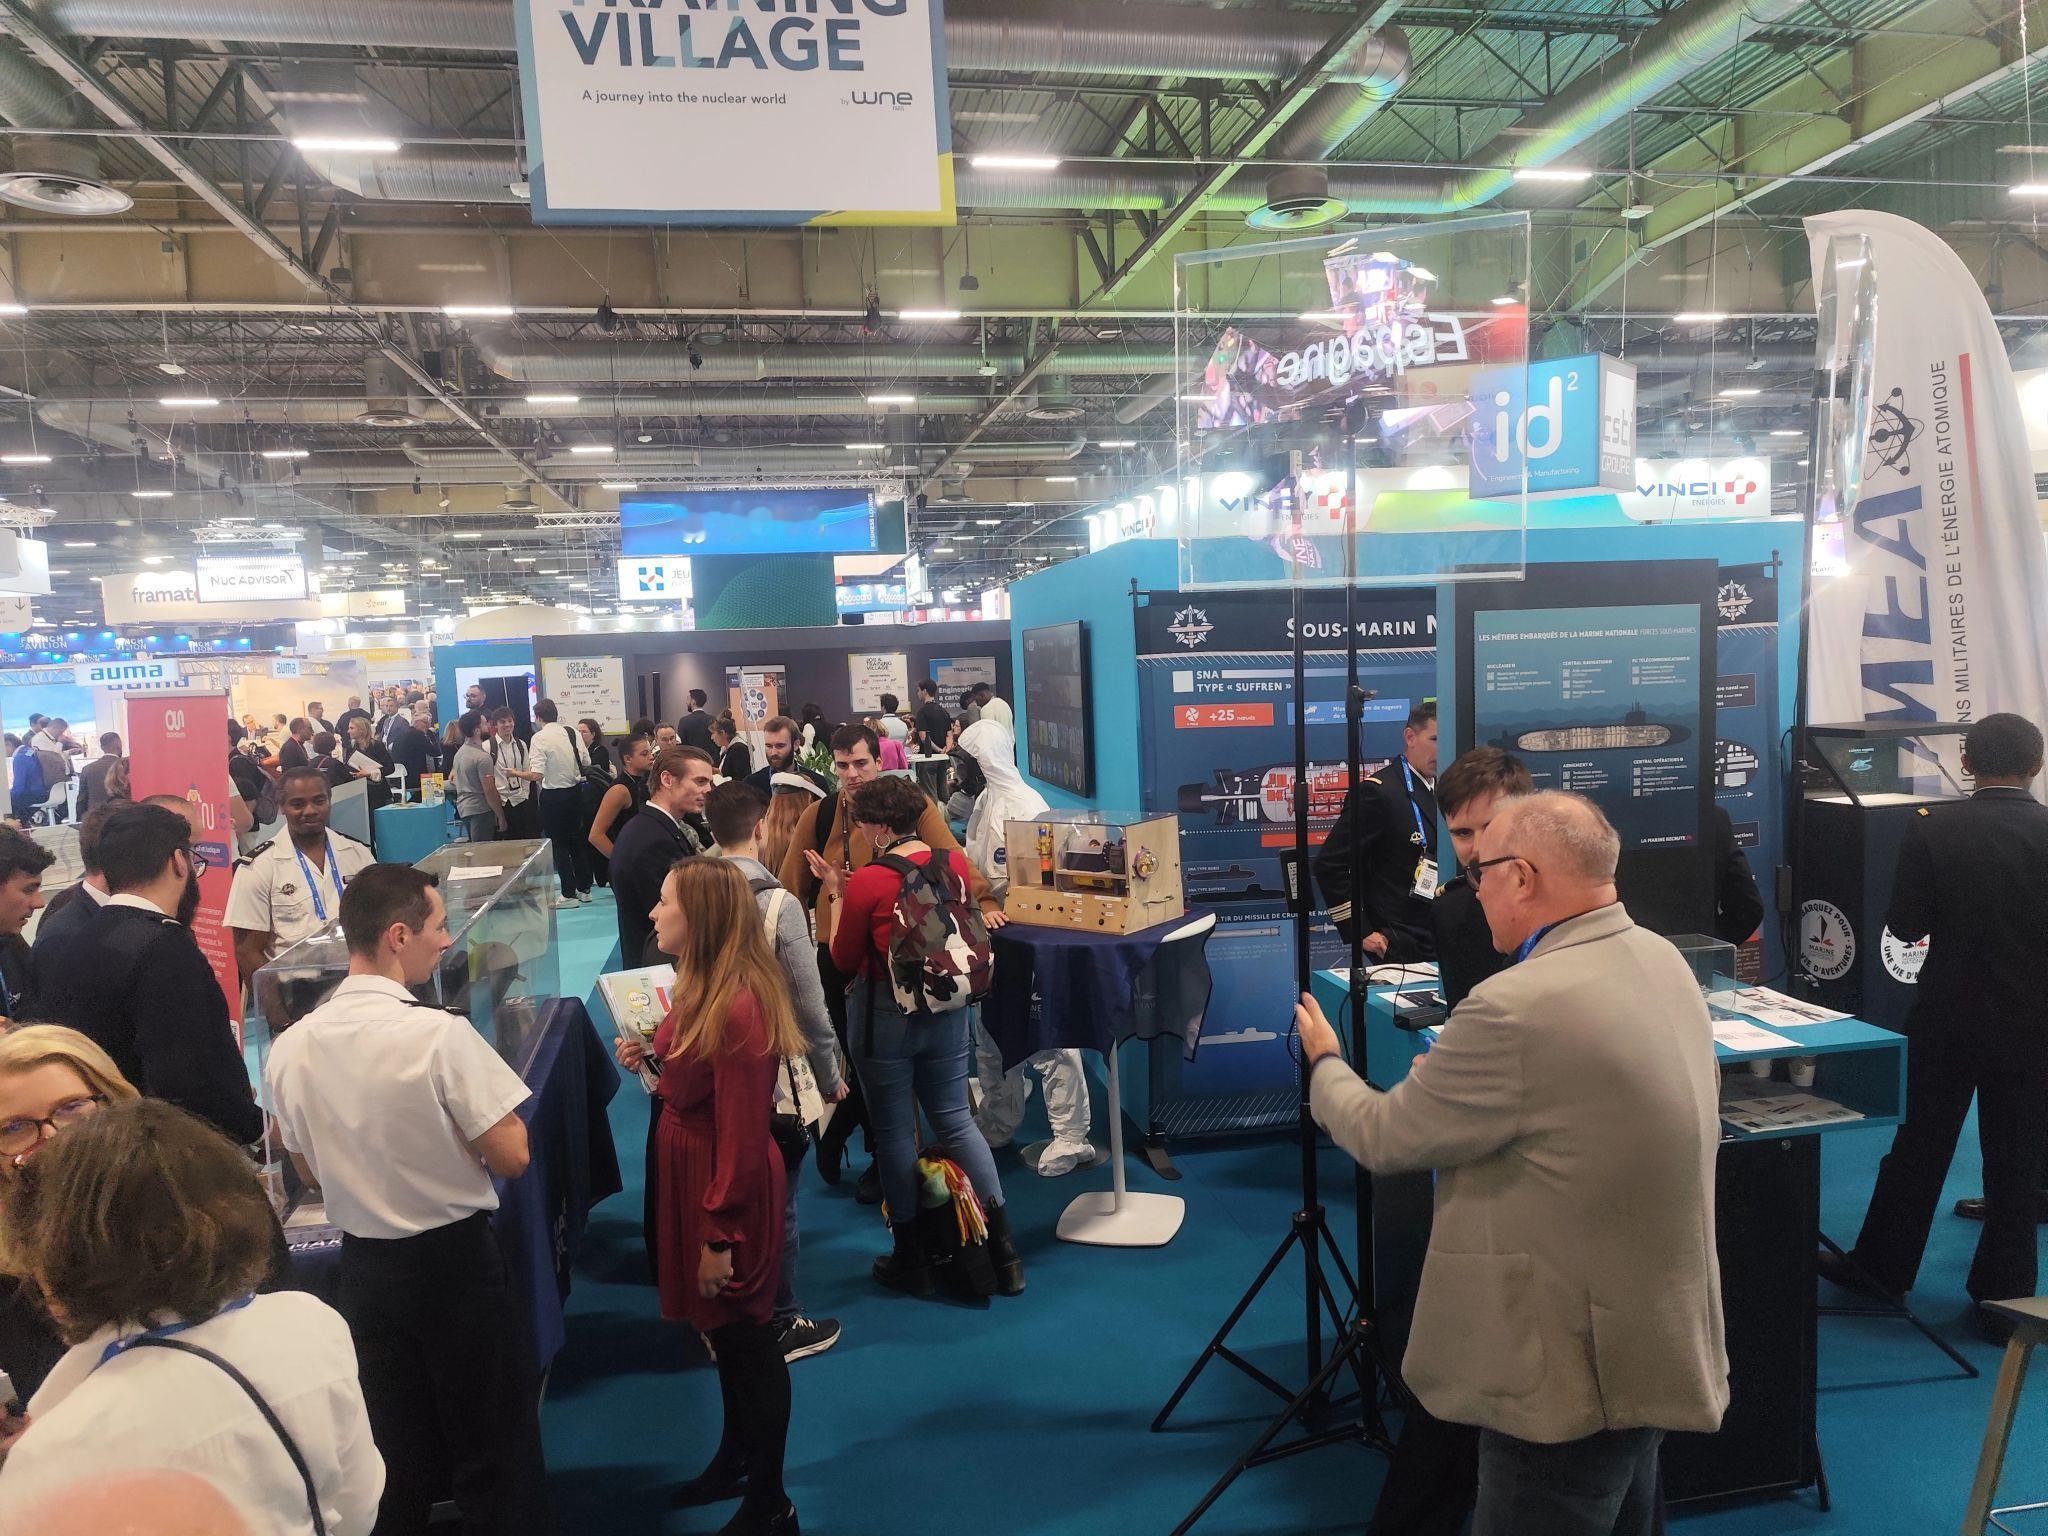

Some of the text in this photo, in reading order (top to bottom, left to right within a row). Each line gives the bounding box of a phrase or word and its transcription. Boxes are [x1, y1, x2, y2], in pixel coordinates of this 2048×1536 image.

[558, 10, 865, 71] VILLAGE
[582, 90, 786, 105] A journey into the nuclear world
[851, 90, 913, 106] wne
[1930, 360, 1952, 455] ATOMIQUE
[1600, 455, 1631, 476] GROUPE
[1636, 482, 1718, 497] VINCI
[1691, 498, 1726, 506] ENERGIES
[1937, 460, 1963, 556] L'ÉNERGIE
[1281, 512, 1320, 521] ENGIES
[1121, 519, 1144, 538] VINCI
[238, 574, 286, 586] ADVISOR
[1947, 560, 1964, 588] DE
[132, 587, 199, 603] framat
[1491, 632, 1519, 641] MÉTIERS
[1520, 630, 1558, 640] EMBARQUÉS
[1559, 631, 1569, 639] DE
[1605, 628, 1638, 637] NATIONALE
[1640, 628, 1658, 636] FORCES
[1948, 592, 1970, 693] MILITAIRES
[90, 664, 163, 681] auma
[275, 660, 297, 674] auma
[566, 666, 603, 674] TRAINING
[1196, 670, 1219, 680] SNA
[1196, 683, 1224, 692] TYPE
[1236, 682, 1283, 692] SUFFREN
[939, 701, 961, 709] future
[1209, 709, 1235, 721] +25
[1221, 915, 1233, 923] TIR
[1244, 913, 1270, 921] MISSILE
[1833, 913, 1852, 938] POUR
[1809, 944, 1835, 956] MARINE
[1902, 950, 1929, 958] MARINE
[1883, 946, 1905, 977] UNE VIE
